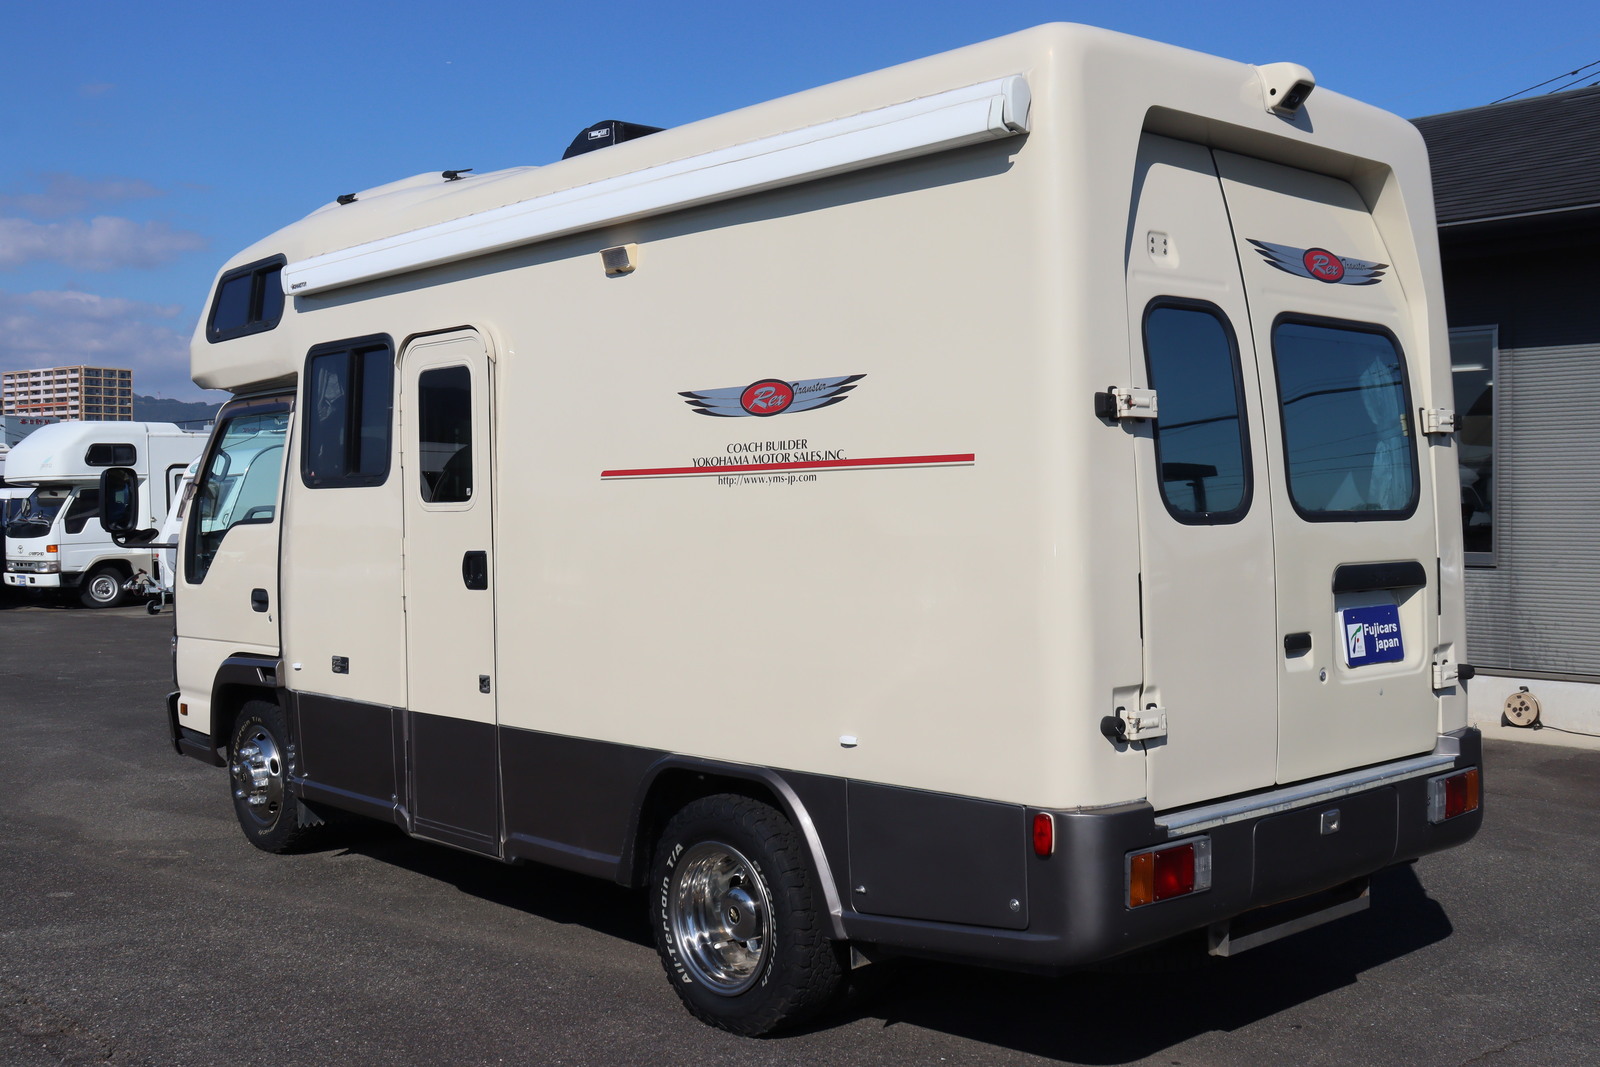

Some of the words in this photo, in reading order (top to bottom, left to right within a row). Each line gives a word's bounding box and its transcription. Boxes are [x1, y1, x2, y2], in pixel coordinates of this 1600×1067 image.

[1311, 254, 1339, 276] Rex
[750, 386, 786, 410] Rex
[726, 442, 763, 454] COACH
[765, 439, 808, 451] BUILDER
[692, 454, 750, 468] YOKOHAMA
[752, 452, 790, 465] MOTOR
[718, 472, 817, 487] http://www.yms-jp.com
[1363, 623, 1397, 637] Fujicars
[1375, 637, 1399, 652] japan
[666, 843, 684, 869] T/A
[660, 876, 693, 984] All-Terrain
